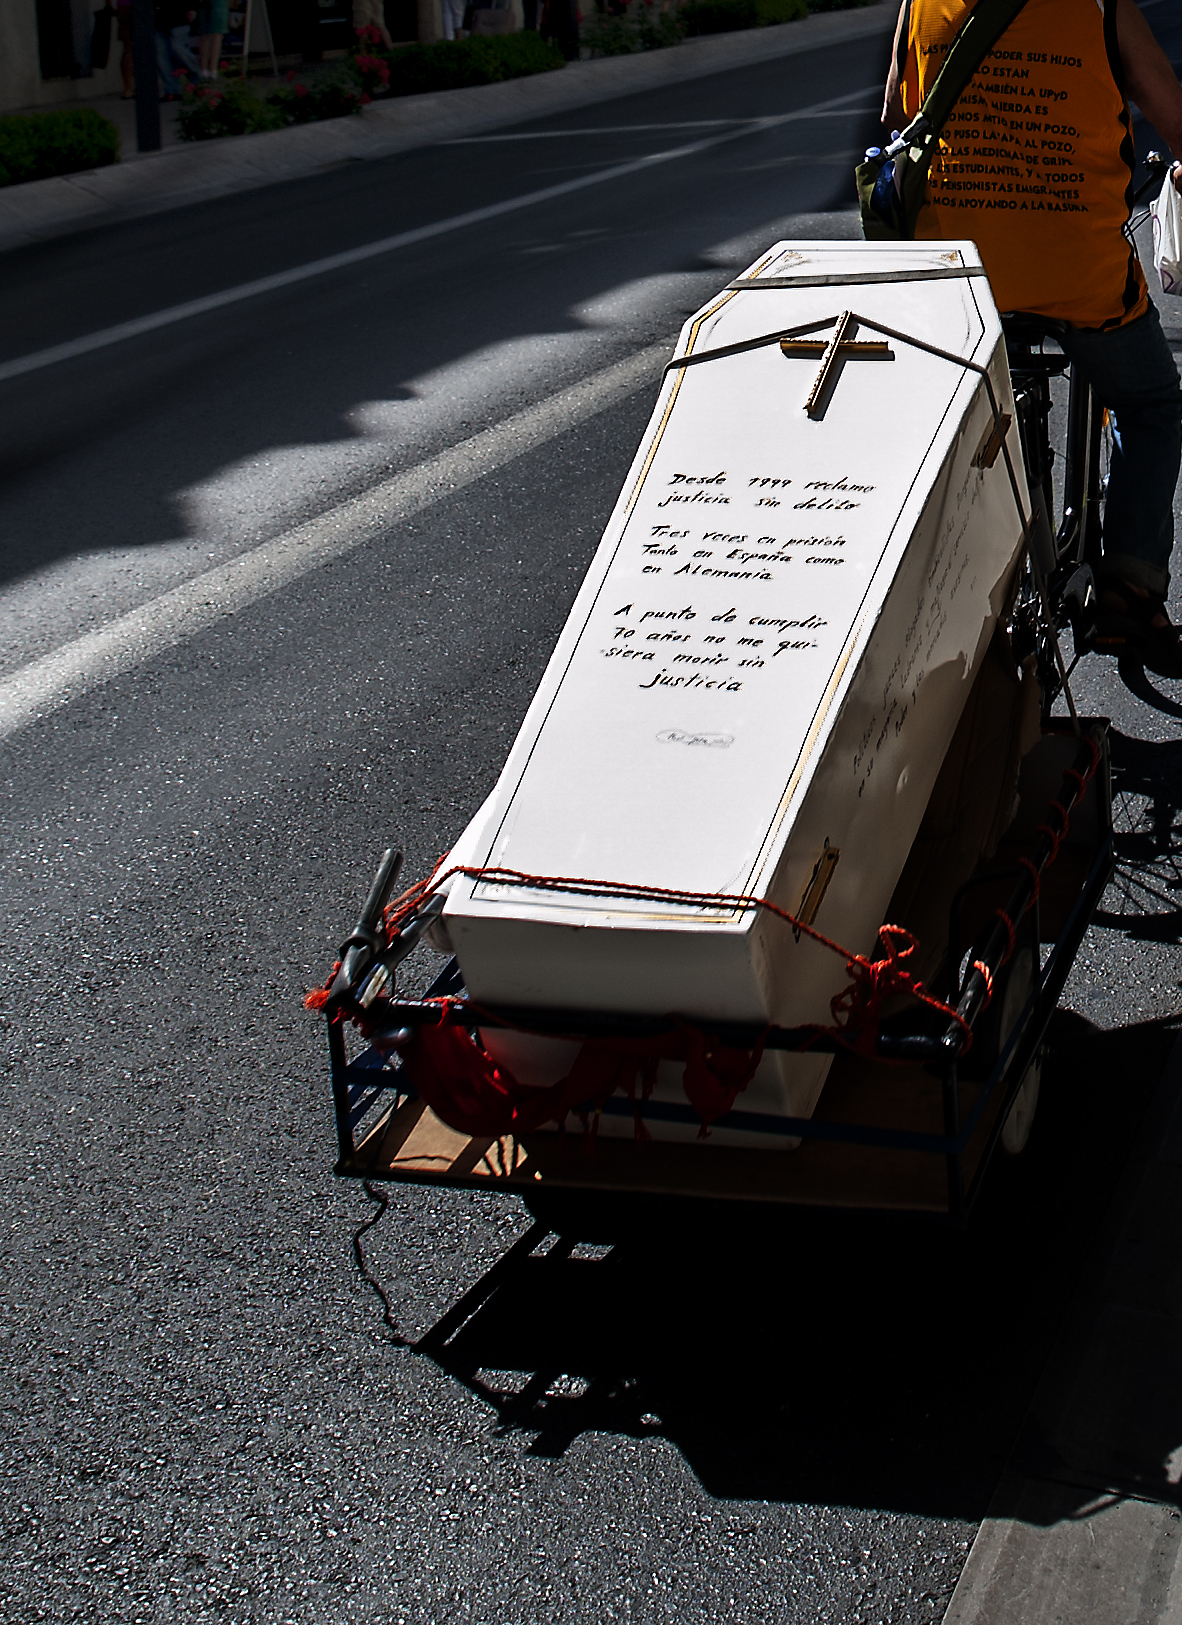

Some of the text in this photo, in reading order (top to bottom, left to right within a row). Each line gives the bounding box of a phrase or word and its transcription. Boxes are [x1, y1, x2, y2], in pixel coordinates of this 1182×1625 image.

[1027, 53, 1047, 63] SUS
[1051, 54, 1082, 67] HIJOS
[993, 67, 1029, 78] ESTAN
[1021, 86, 1035, 97] LA
[1040, 89, 1067, 101] UPyD
[992, 101, 1031, 114] MIERDA
[1036, 106, 1048, 115] ES
[1010, 120, 1023, 129] EN
[1026, 122, 1041, 131] UN
[1044, 124, 1079, 137] POZO,
[954, 129, 979, 139] PUSO
[1025, 140, 1037, 148] AL
[1041, 141, 1075, 154] POZO,
[951, 147, 969, 156] LAS
[1026, 156, 1038, 164] DE
[953, 164, 1023, 178] ESTUDIANTES,
[1026, 168, 1032, 177] Y
[1045, 173, 1084, 182] TODOS
[941, 181, 1013, 193] PENSIONISTAS
[958, 198, 1017, 208] APOYANDO
[1020, 201, 1028, 209] A
[1031, 201, 1045, 210] LA
[668, 471, 727, 485] Desde
[804, 477, 876, 493] reclamo
[658, 491, 860, 510] justicia sin delito
[649, 525, 689, 539] Tres
[701, 532, 748, 544] veces
[758, 536, 776, 546] en
[641, 544, 846, 565] Tanto en España como
[641, 562, 774, 580] en Alemania
[614, 603, 828, 633] A punto de cumplir
[646, 630, 691, 642] años
[704, 635, 726, 643] no
[737, 637, 764, 647] me
[673, 653, 728, 665] morir
[738, 656, 765, 667] sin
[639, 669, 743, 691] justicia
